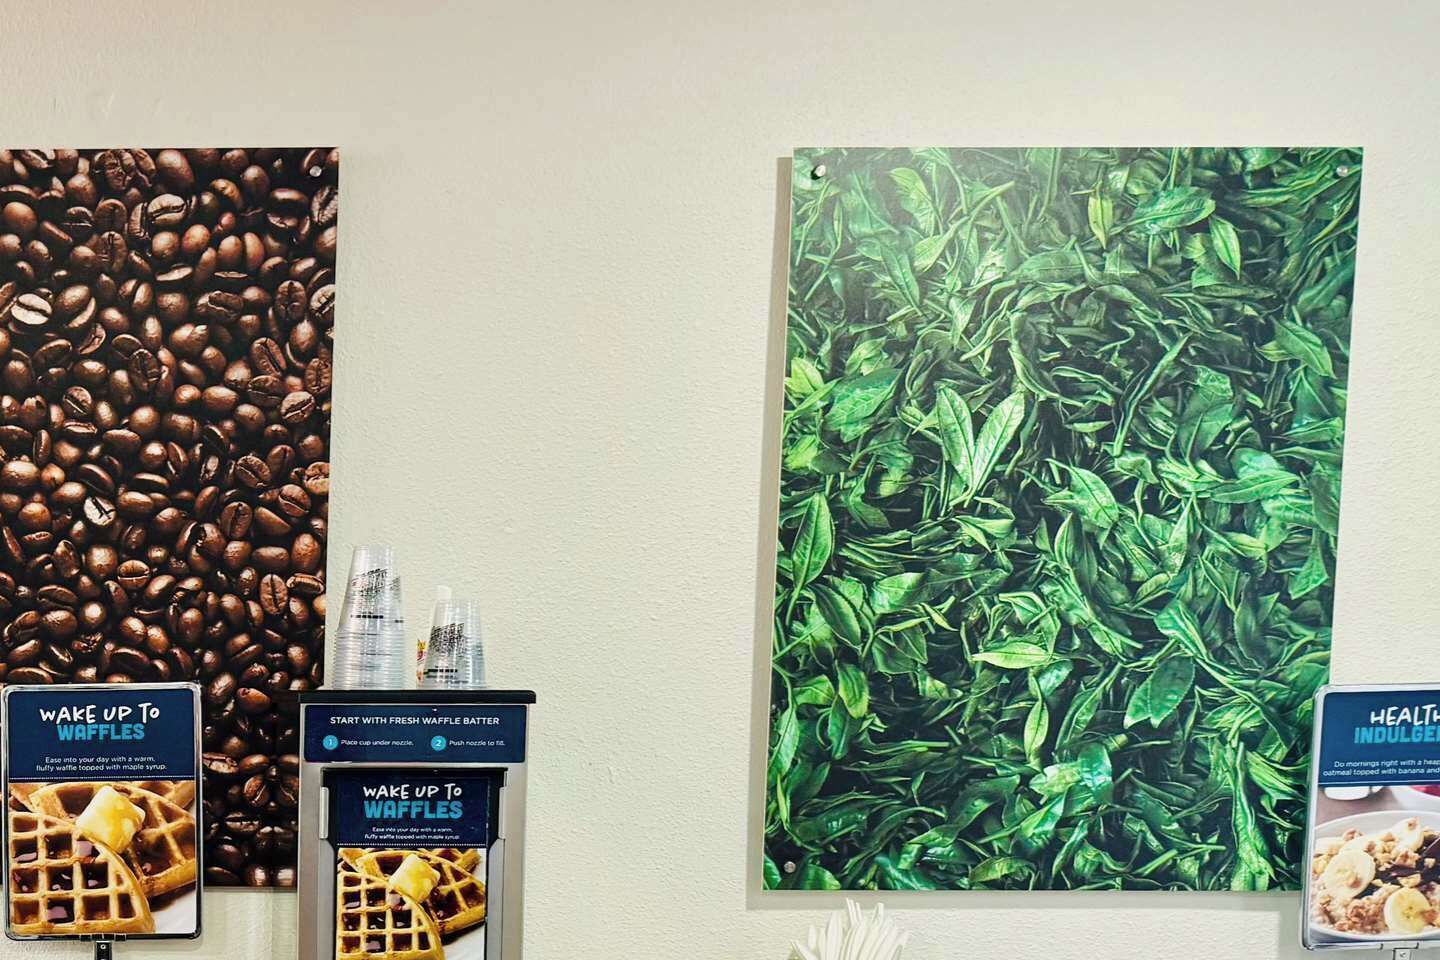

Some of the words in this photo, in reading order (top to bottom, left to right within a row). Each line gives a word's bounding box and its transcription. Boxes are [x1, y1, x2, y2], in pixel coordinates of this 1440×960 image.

[39, 705, 97, 725] WAKE
[103, 705, 132, 721] UP
[329, 716, 360, 724] START
[362, 716, 387, 724] WITH
[389, 716, 420, 725] FRESH
[422, 717, 461, 725] WAFFLE
[463, 717, 500, 725] BATTER
[56, 723, 145, 741] WAFFLES
[1353, 725, 1440, 744] INDULGE
[45, 756, 61, 764] Ease
[96, 756, 110, 764] day
[1345, 760, 1380, 768] mornings
[1381, 759, 1399, 767] right
[36, 764, 54, 772] fluffy
[79, 764, 104, 772] topped
[122, 763, 144, 772] maple
[1353, 768, 1380, 776] topped
[363, 784, 410, 800] WAKE
[415, 785, 440, 798] UP
[363, 800, 463, 819] WAFFLES
